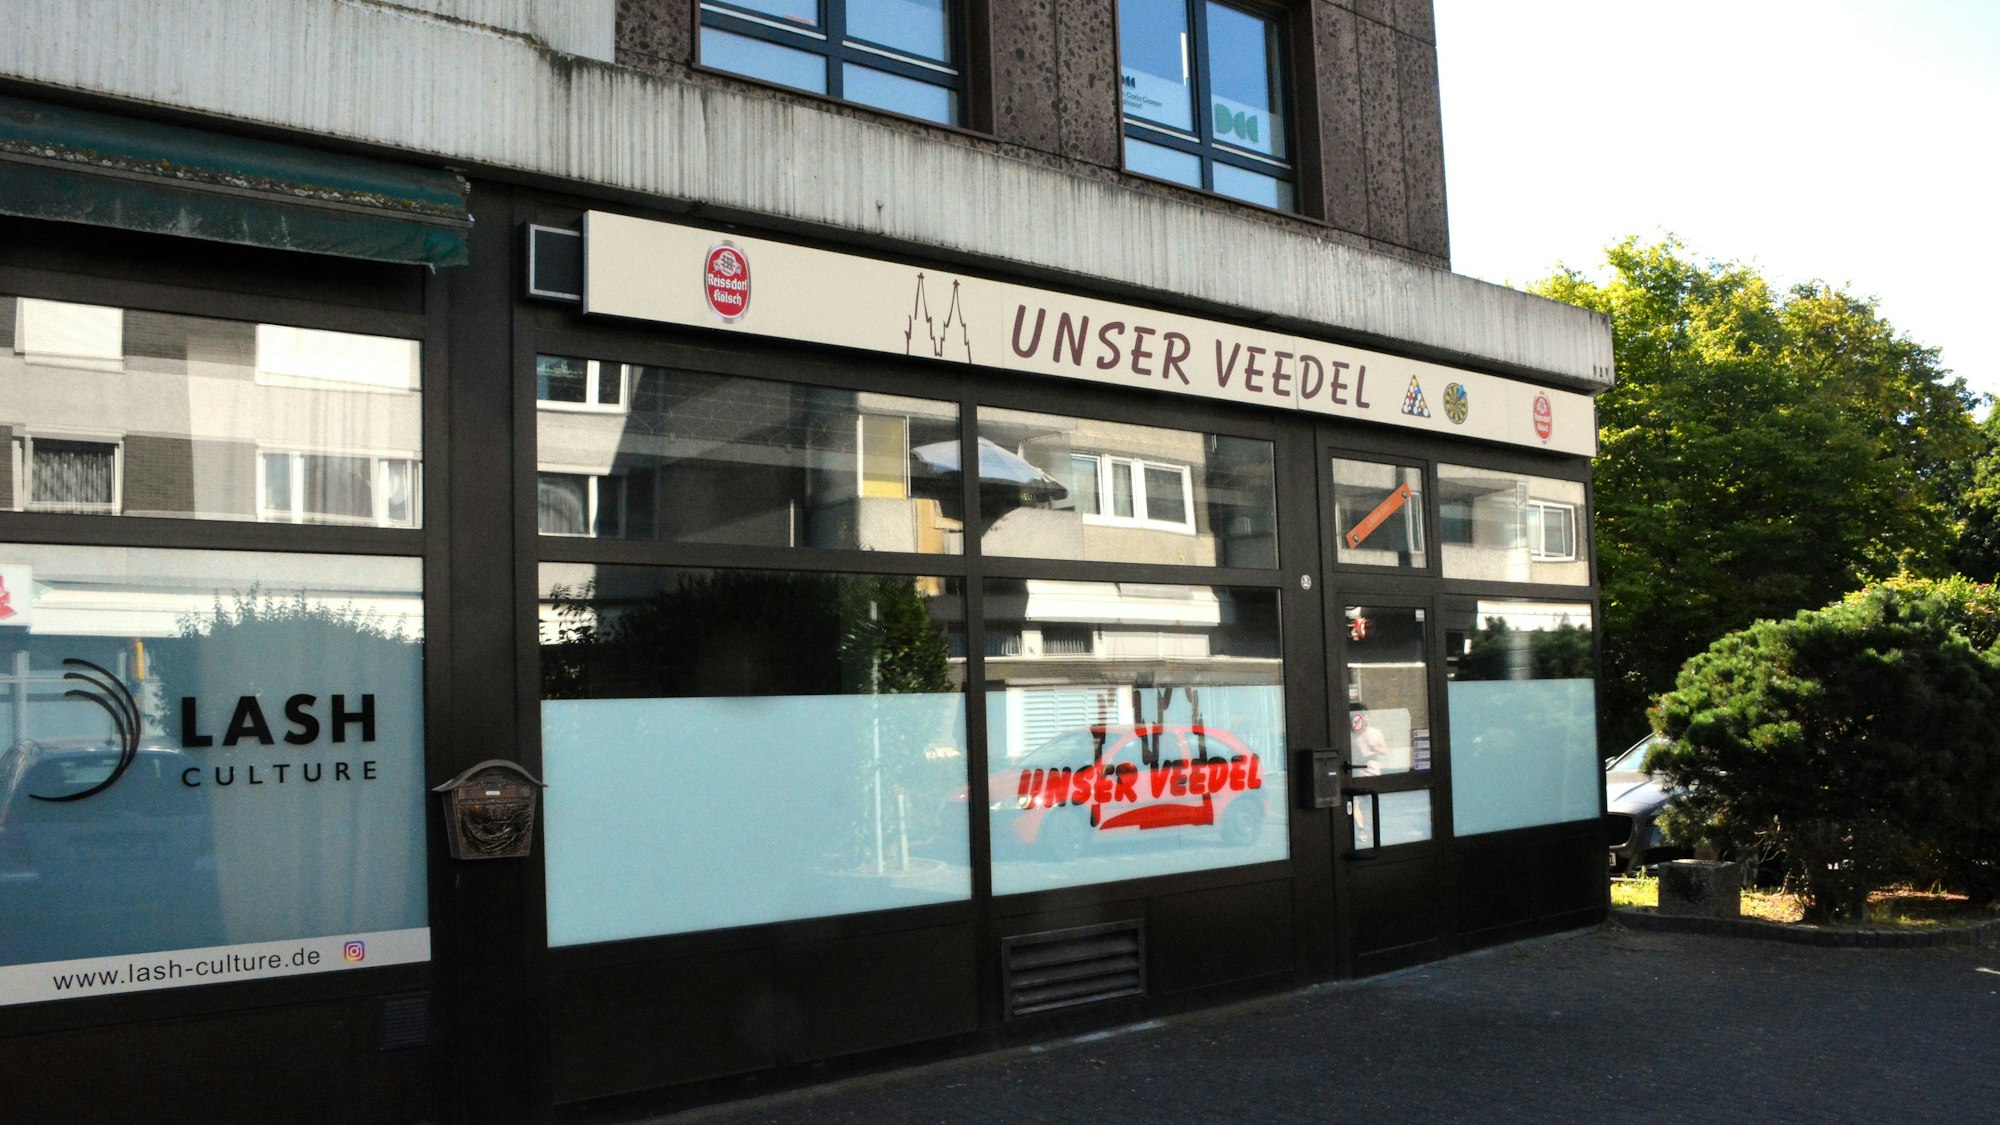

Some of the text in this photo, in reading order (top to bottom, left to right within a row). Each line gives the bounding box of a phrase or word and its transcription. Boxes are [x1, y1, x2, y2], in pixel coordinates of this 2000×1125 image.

[707, 273, 747, 290] Reissdorf
[713, 289, 742, 306] Kölsch
[1011, 304, 1371, 409] UNSER VEEDEL
[181, 693, 376, 748] LASH
[181, 760, 377, 788] CULTURE
[1017, 753, 1263, 809] UNSER VEEDEL
[53, 947, 321, 990] www.lash-culture.de
